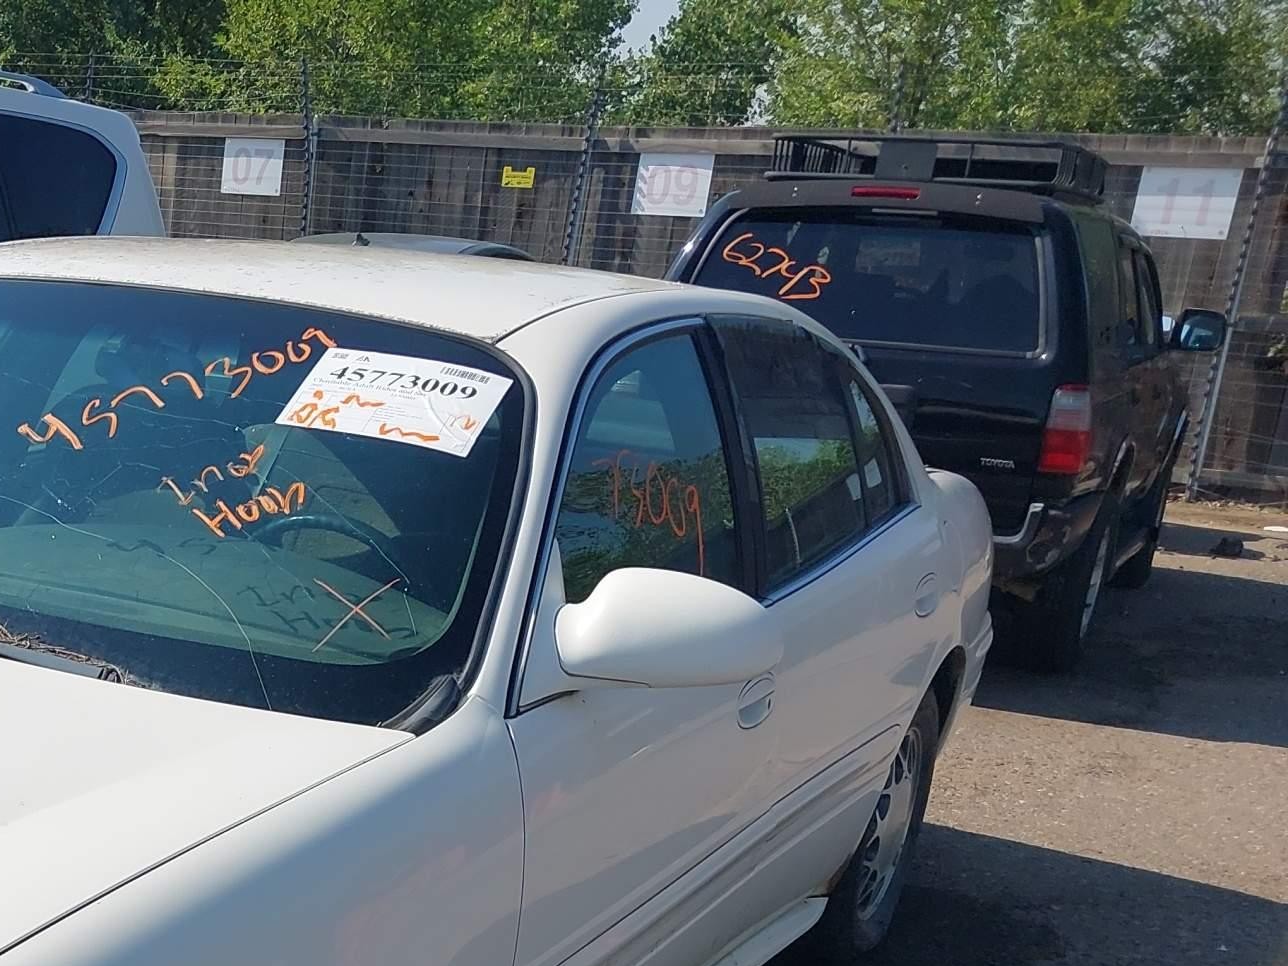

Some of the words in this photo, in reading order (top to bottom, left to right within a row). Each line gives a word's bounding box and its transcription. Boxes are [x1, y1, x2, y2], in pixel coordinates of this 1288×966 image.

[232, 147, 274, 186] 07
[646, 164, 699, 206] 09
[1158, 177, 1216, 226] 11
[722, 232, 832, 300] 62743
[16, 327, 338, 451] 45773009
[329, 365, 479, 400] 45773009
[979, 457, 1016, 470] TOYOTA
